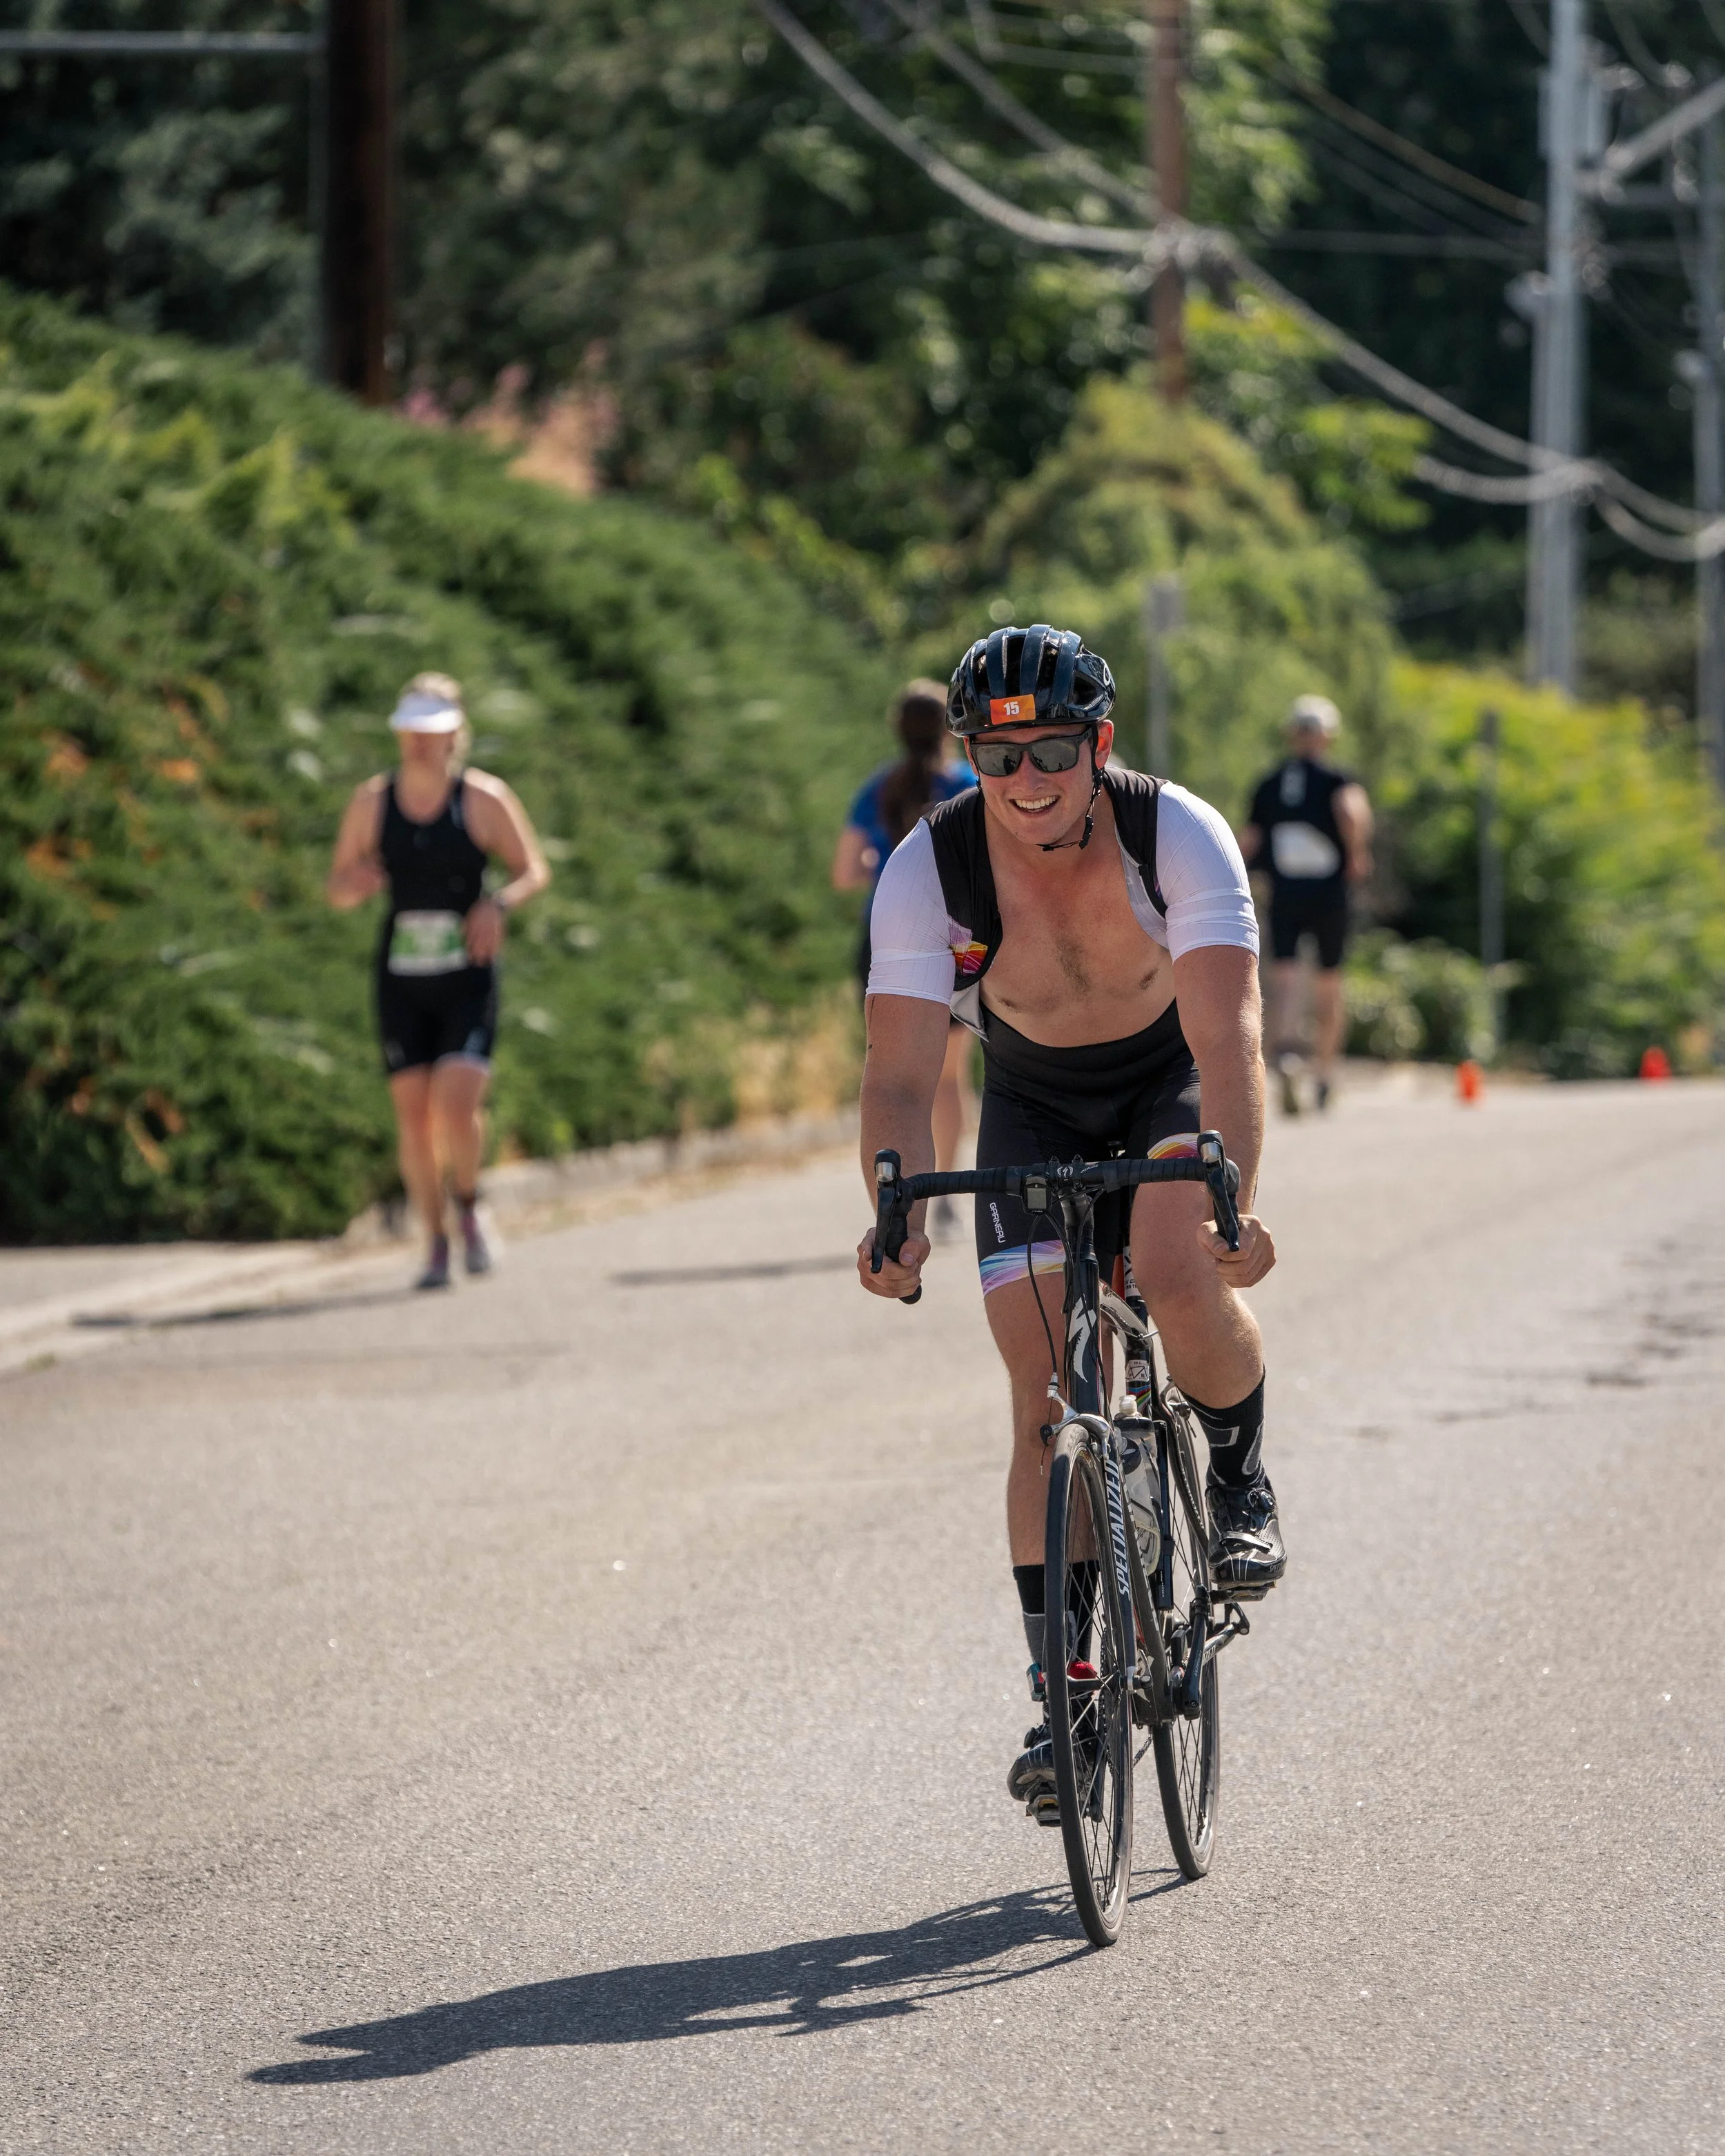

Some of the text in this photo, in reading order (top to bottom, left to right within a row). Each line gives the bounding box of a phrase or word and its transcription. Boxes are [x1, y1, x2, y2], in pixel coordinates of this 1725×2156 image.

[1003, 701, 1020, 715] 15
[989, 1202, 1006, 1243] GARNEAU
[1104, 1458, 1130, 1601] SPECIALIZED
